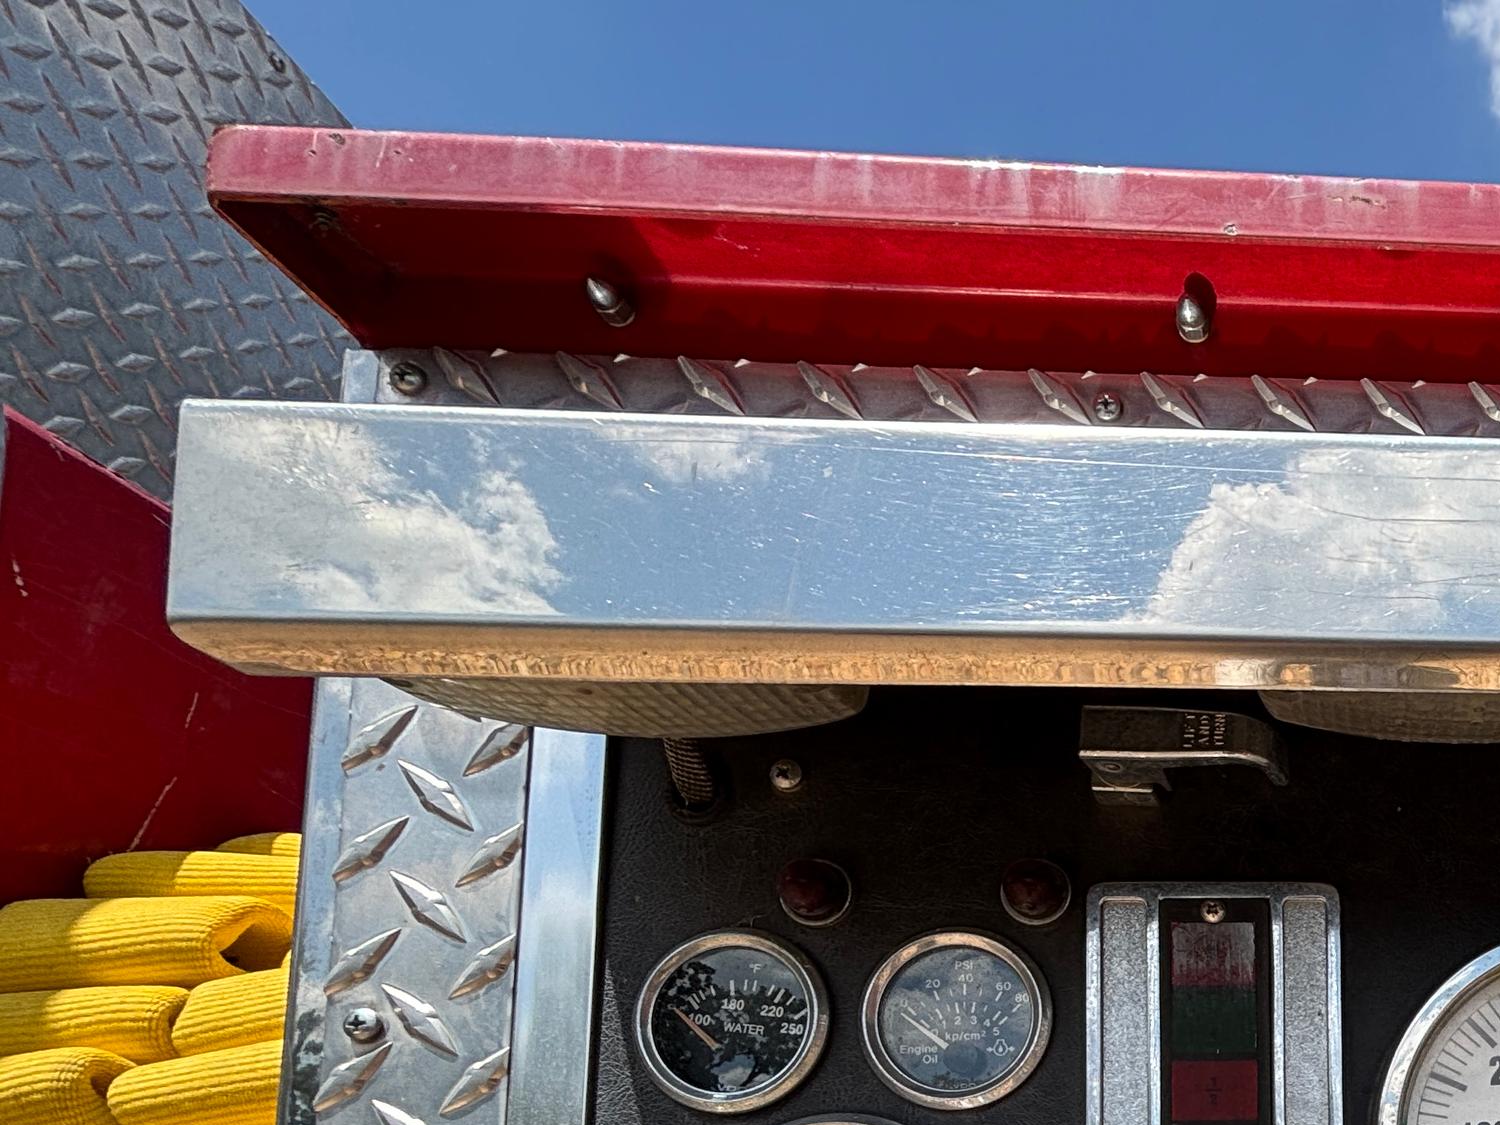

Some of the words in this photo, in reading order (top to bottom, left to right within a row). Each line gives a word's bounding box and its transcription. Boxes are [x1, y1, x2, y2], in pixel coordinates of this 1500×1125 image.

[1198, 715, 1210, 746] AND
[955, 961, 973, 970] PSI
[958, 974, 973, 983] 40
[925, 979, 941, 988] 20
[995, 982, 1011, 991] 60
[1015, 993, 1030, 1002] 80
[721, 998, 744, 1011] 180
[760, 1005, 784, 1017] 220
[689, 1014, 711, 1026] 100
[954, 1017, 961, 1025] 2
[970, 1016, 977, 1025] 3
[983, 1018, 991, 1027] 4
[723, 1022, 765, 1036] WATER
[780, 1023, 803, 1035] 250
[993, 1027, 1000, 1036] 5
[900, 1045, 938, 1055] Engine
[922, 1054, 938, 1064] Oil
